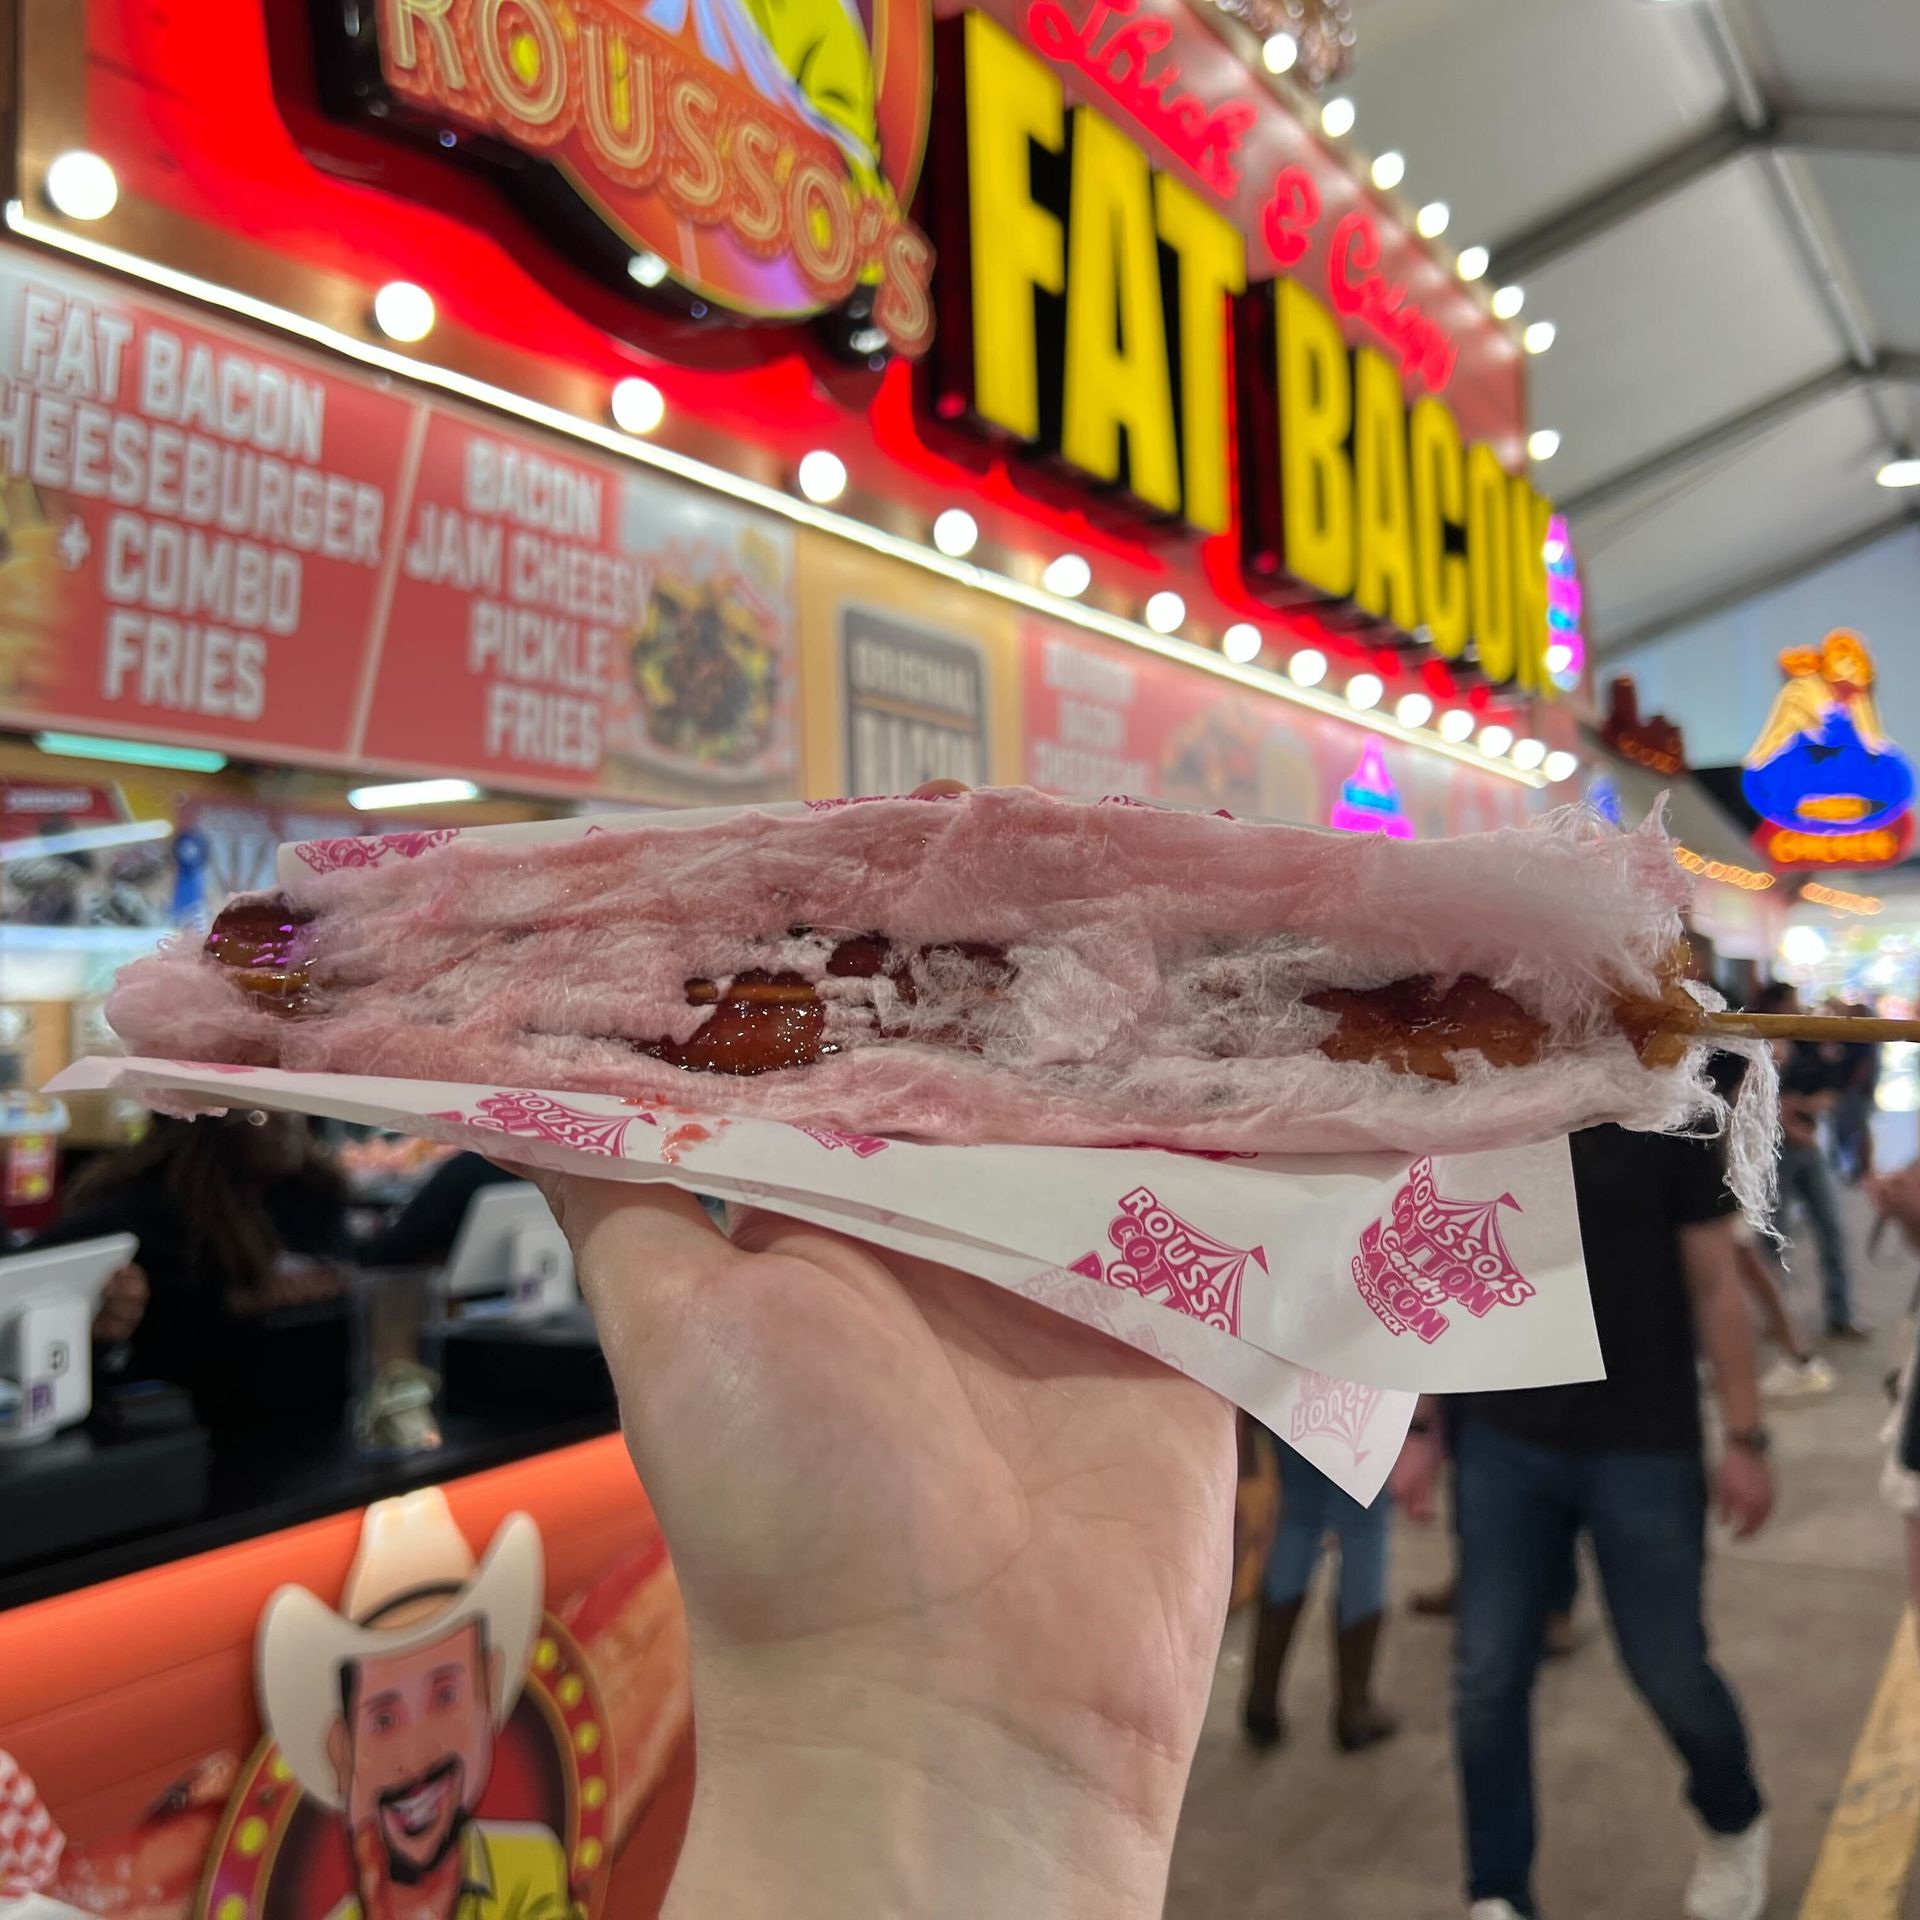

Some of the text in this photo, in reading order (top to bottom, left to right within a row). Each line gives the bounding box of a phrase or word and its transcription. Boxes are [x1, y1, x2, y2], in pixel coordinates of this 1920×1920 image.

[20, 293, 327, 464] FAT BACON
[964, 8, 1556, 702] FAT BACON
[0, 376, 384, 567] HEESEBURGER
[465, 437, 604, 540] BACON
[104, 512, 303, 637] COMBO
[405, 502, 503, 597] JAM
[104, 611, 267, 723] FRIES
[469, 598, 612, 694] PICKLE
[485, 681, 602, 773] FRIES
[498, 1089, 613, 1157] ROUSS
[1121, 1185, 1233, 1334] ROUSSO
[1360, 1217, 1449, 1342] BACON
[1380, 1227, 1447, 1305] Candy
[1392, 1184, 1499, 1318] COTTON
[1410, 1155, 1535, 1305] ROUSSO'S
[1352, 1256, 1407, 1335] ON-A-STICK
